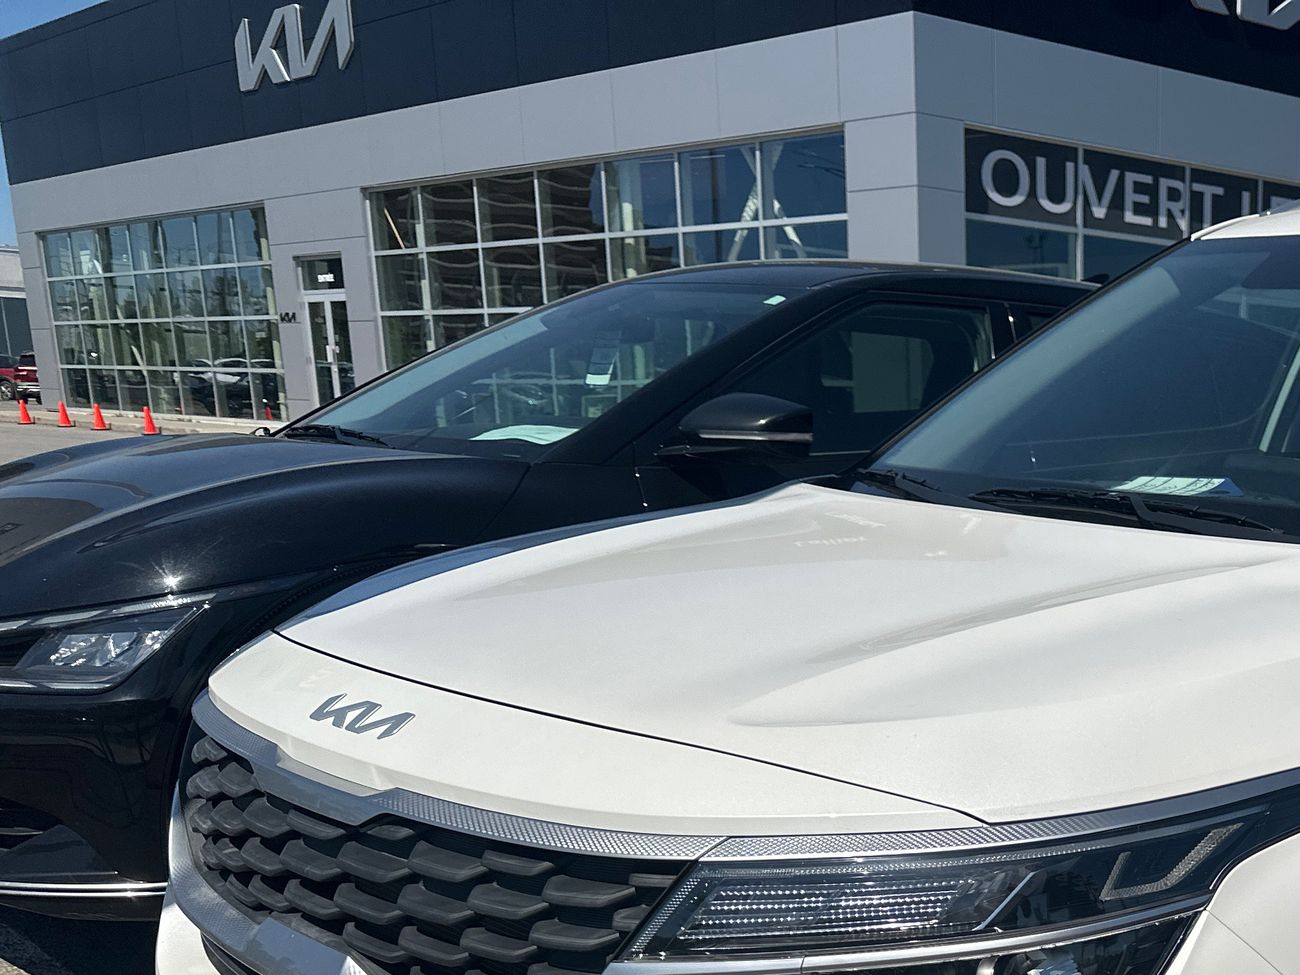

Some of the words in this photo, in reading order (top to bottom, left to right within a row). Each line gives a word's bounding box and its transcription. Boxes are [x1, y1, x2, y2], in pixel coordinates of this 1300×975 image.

[234, 0, 355, 93] KIA
[980, 148, 1225, 237] OUVERT
[309, 692, 416, 740] KIA
